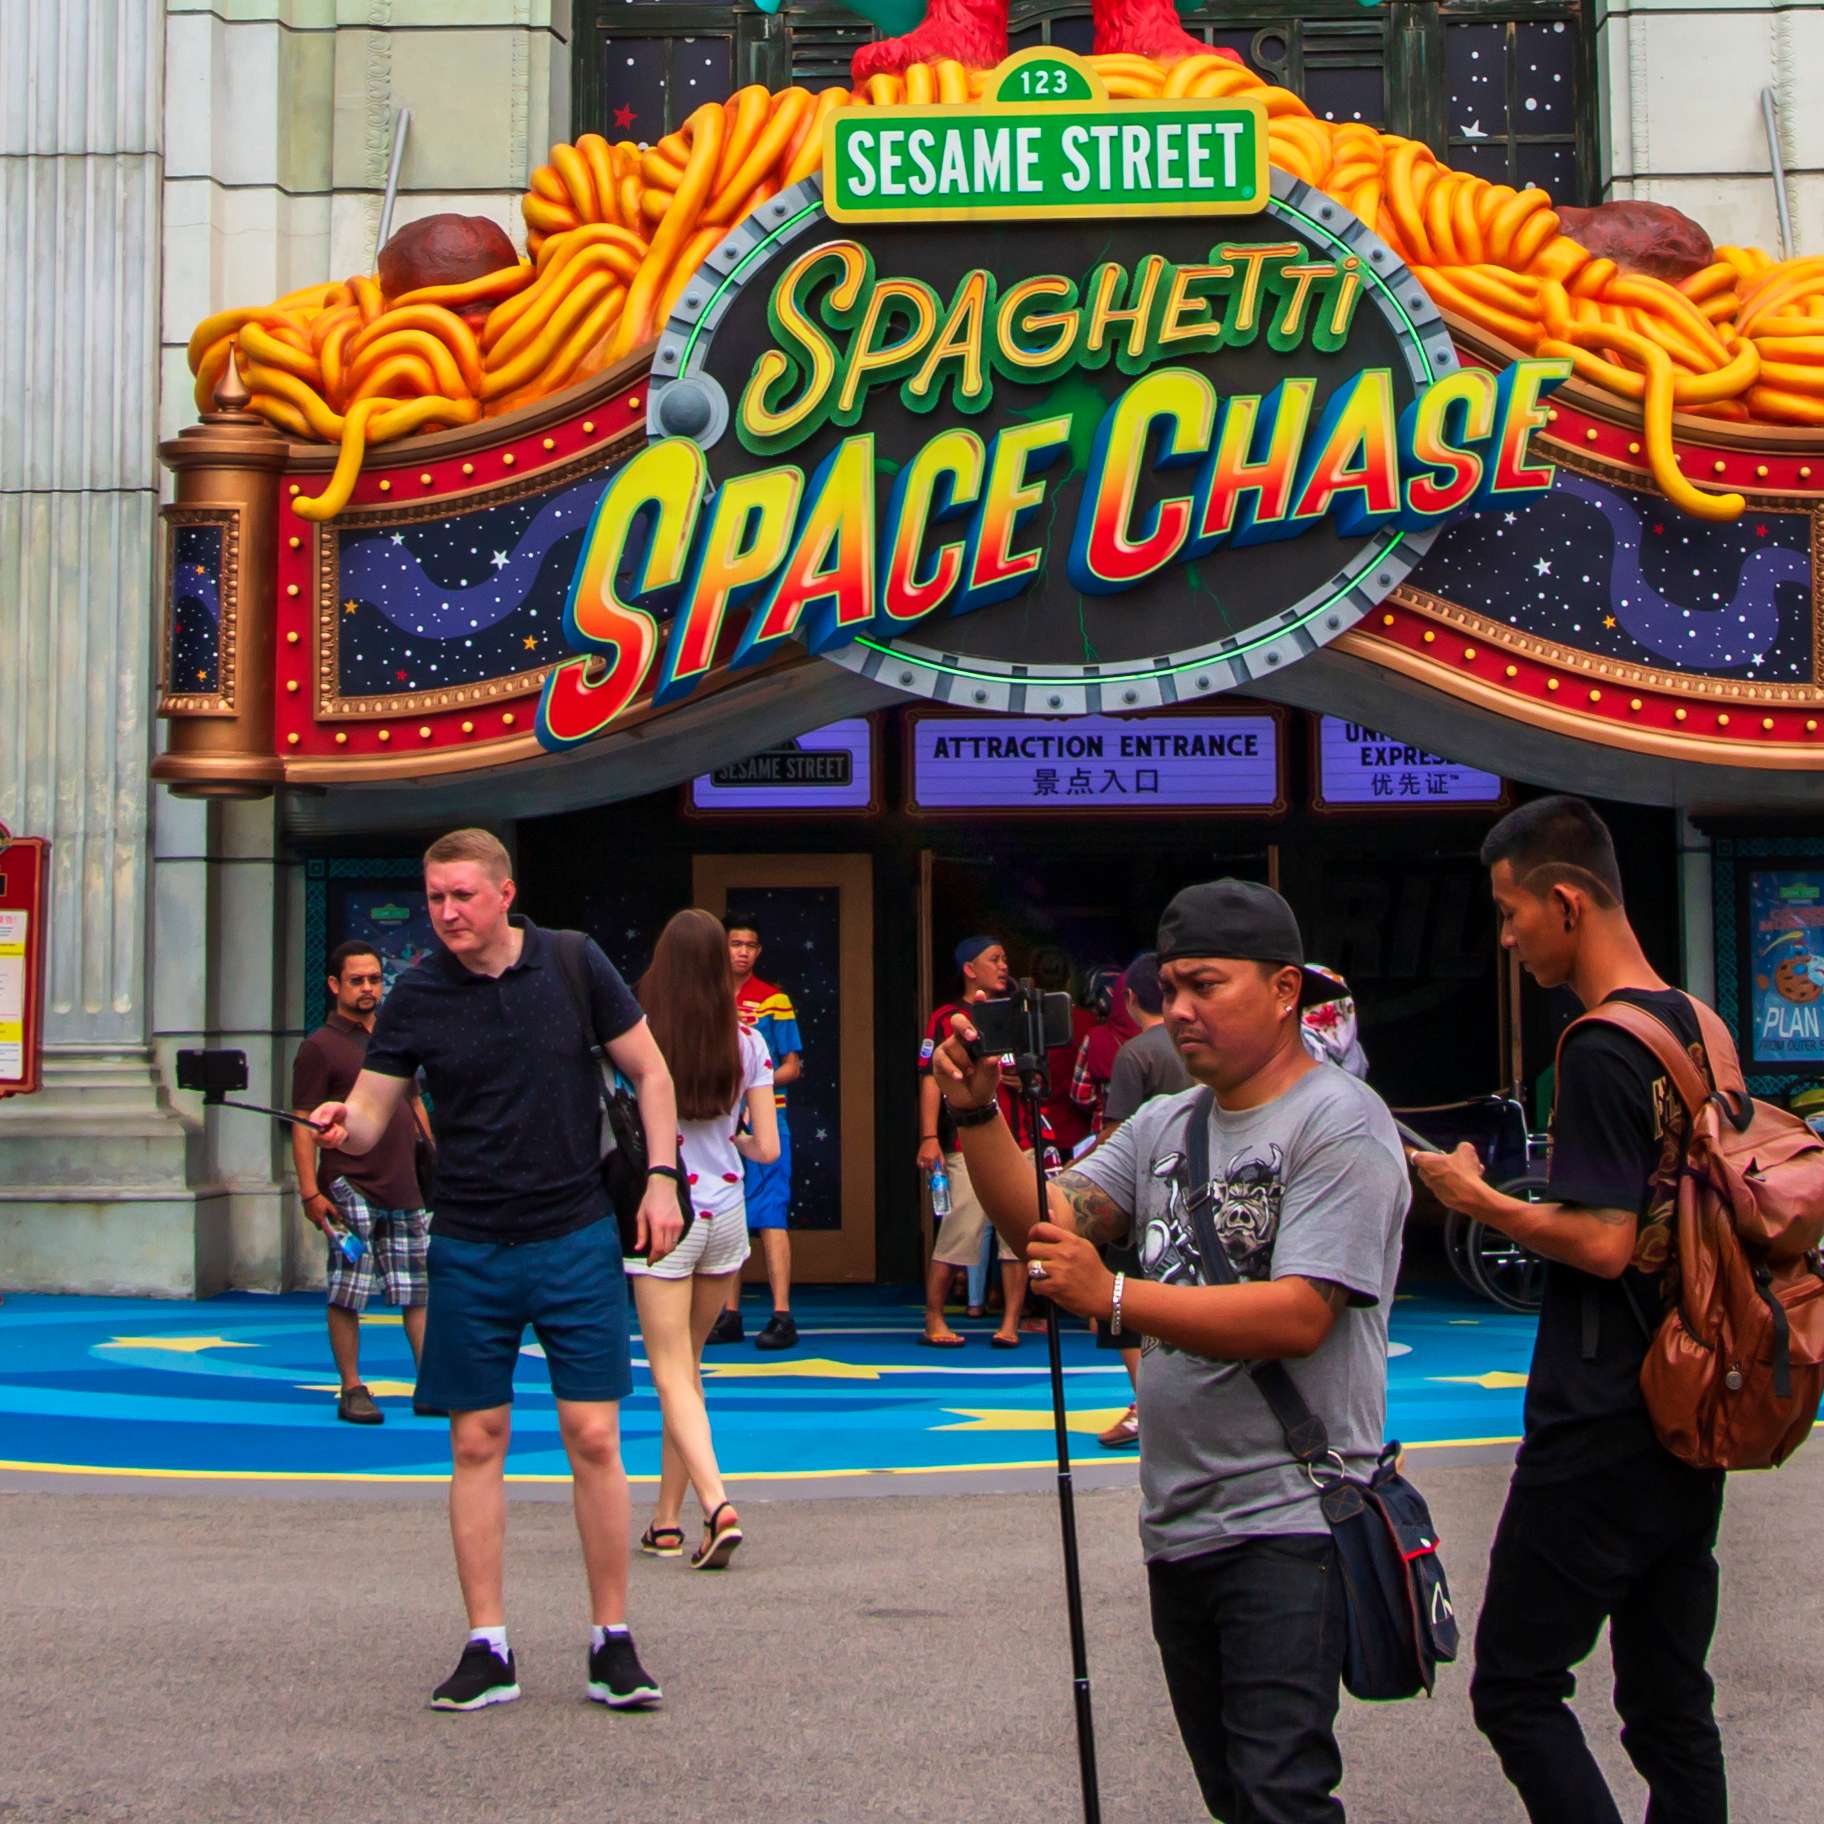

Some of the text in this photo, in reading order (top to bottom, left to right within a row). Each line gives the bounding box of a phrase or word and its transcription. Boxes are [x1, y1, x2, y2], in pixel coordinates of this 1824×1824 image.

[1019, 69, 1068, 95] 123
[847, 122, 1244, 197] SESAME STREET
[538, 357, 1574, 748] SPACE CHASE
[933, 734, 1259, 759] ATTRACTION ENTRANCE
[786, 756, 845, 779] STREET
[1033, 767, 1159, 796] 景点入口
[1762, 1006, 1820, 1039] PLAN
